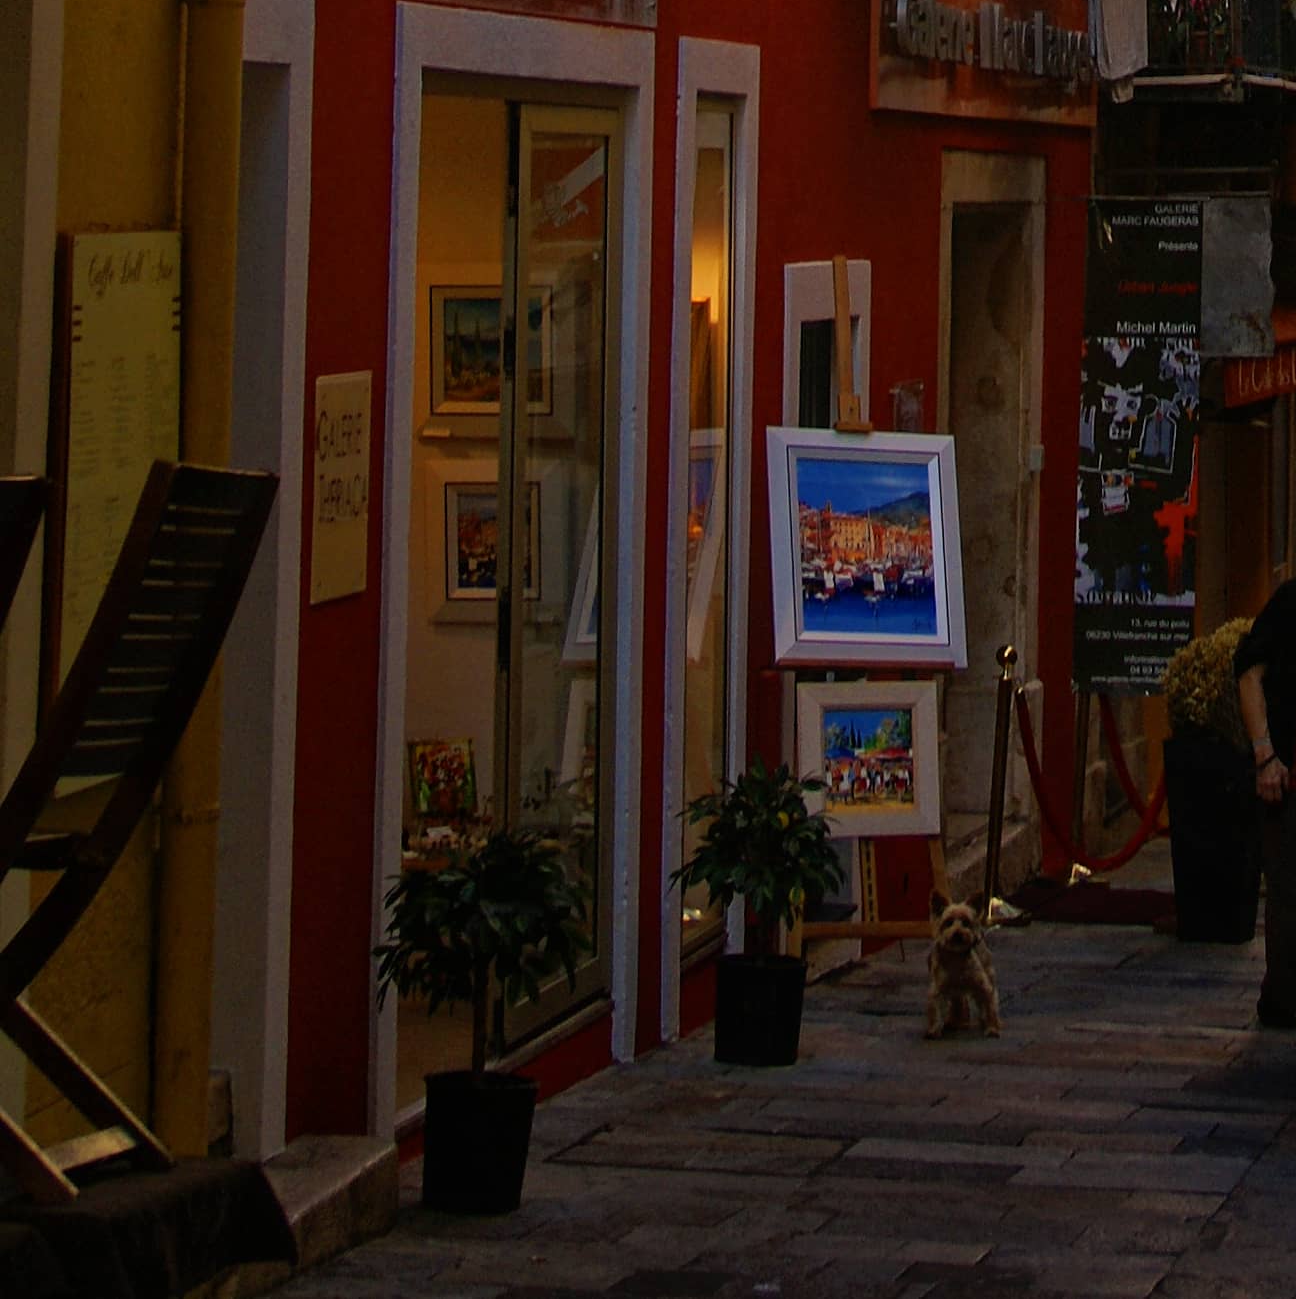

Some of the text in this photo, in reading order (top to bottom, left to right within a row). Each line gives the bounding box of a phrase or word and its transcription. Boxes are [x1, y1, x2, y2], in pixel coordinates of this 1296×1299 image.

[1154, 202, 1200, 215] GALERIE
[1111, 216, 1142, 227] MARC
[1116, 320, 1197, 334] Michel Martin
